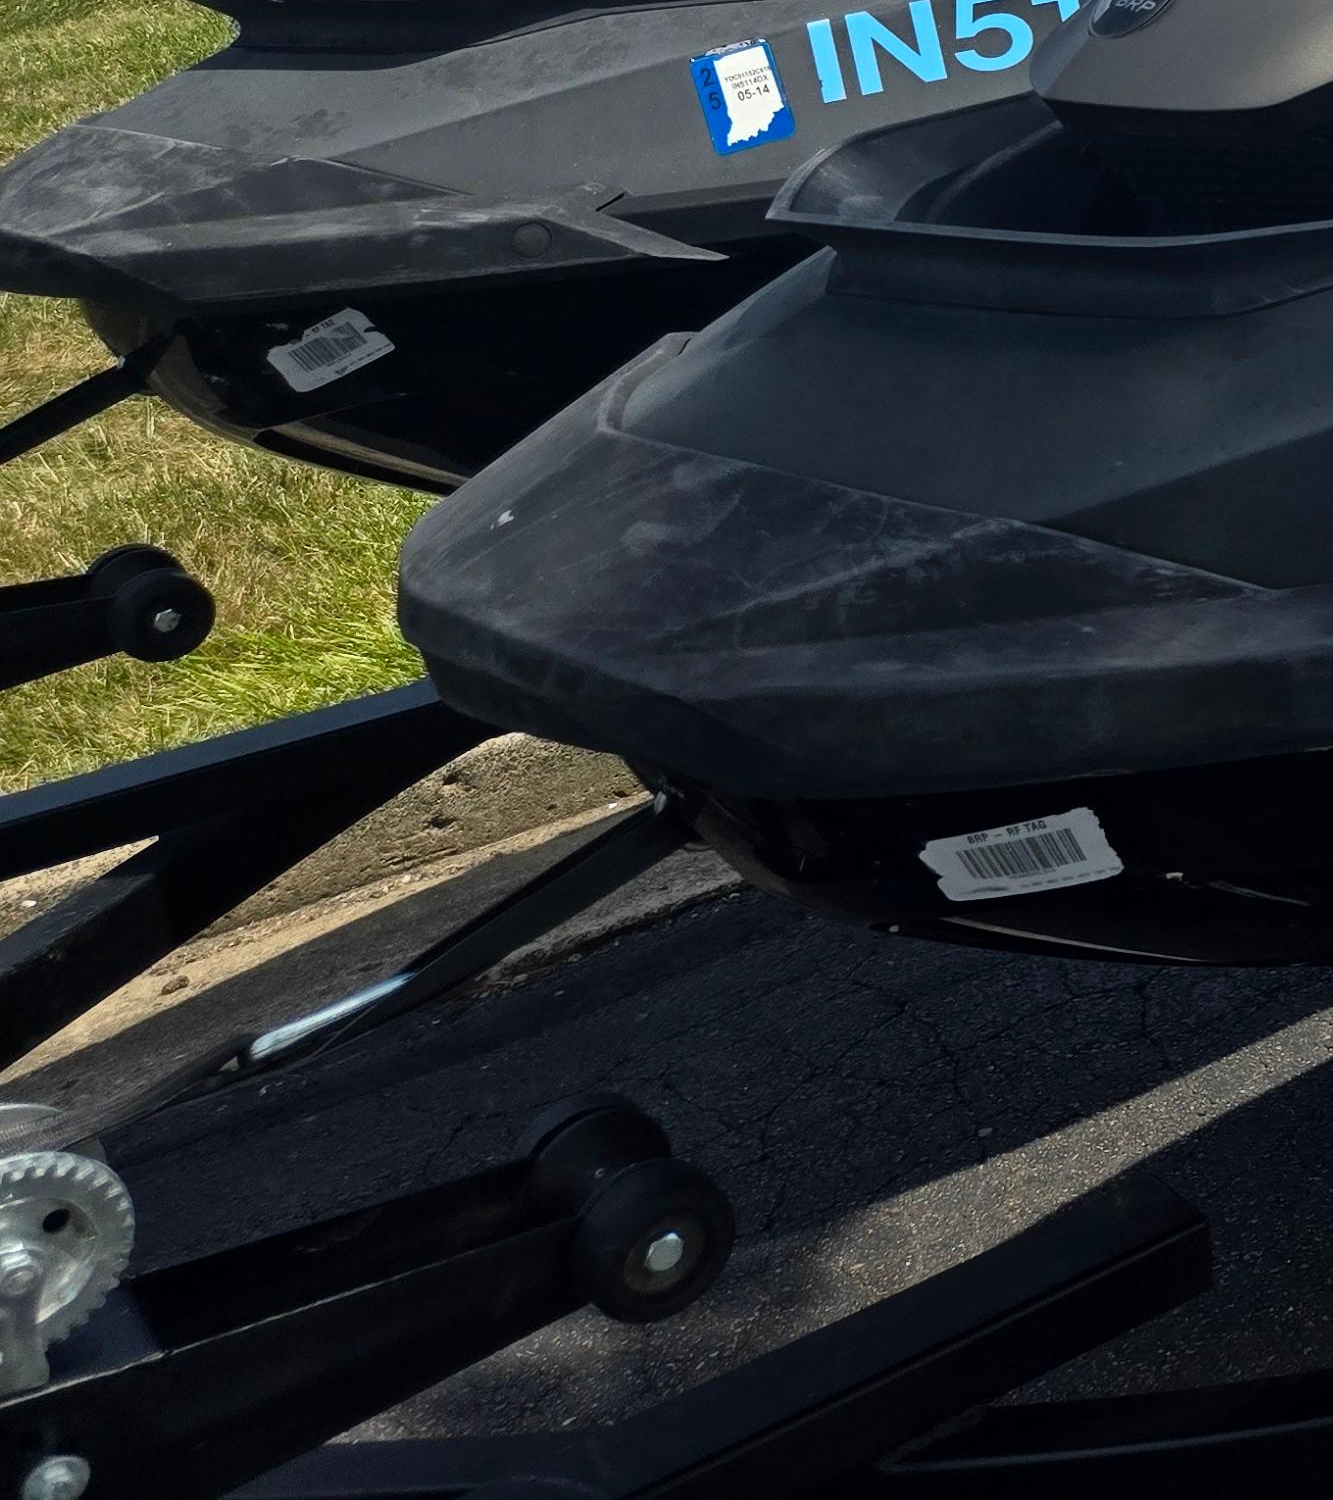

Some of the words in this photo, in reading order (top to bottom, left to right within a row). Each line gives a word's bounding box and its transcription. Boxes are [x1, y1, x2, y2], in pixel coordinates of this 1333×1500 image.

[737, 84, 771, 102] 05-14
[966, 833, 989, 845] BRP
[1006, 826, 1022, 837] RF
[1024, 820, 1047, 834] TAG
